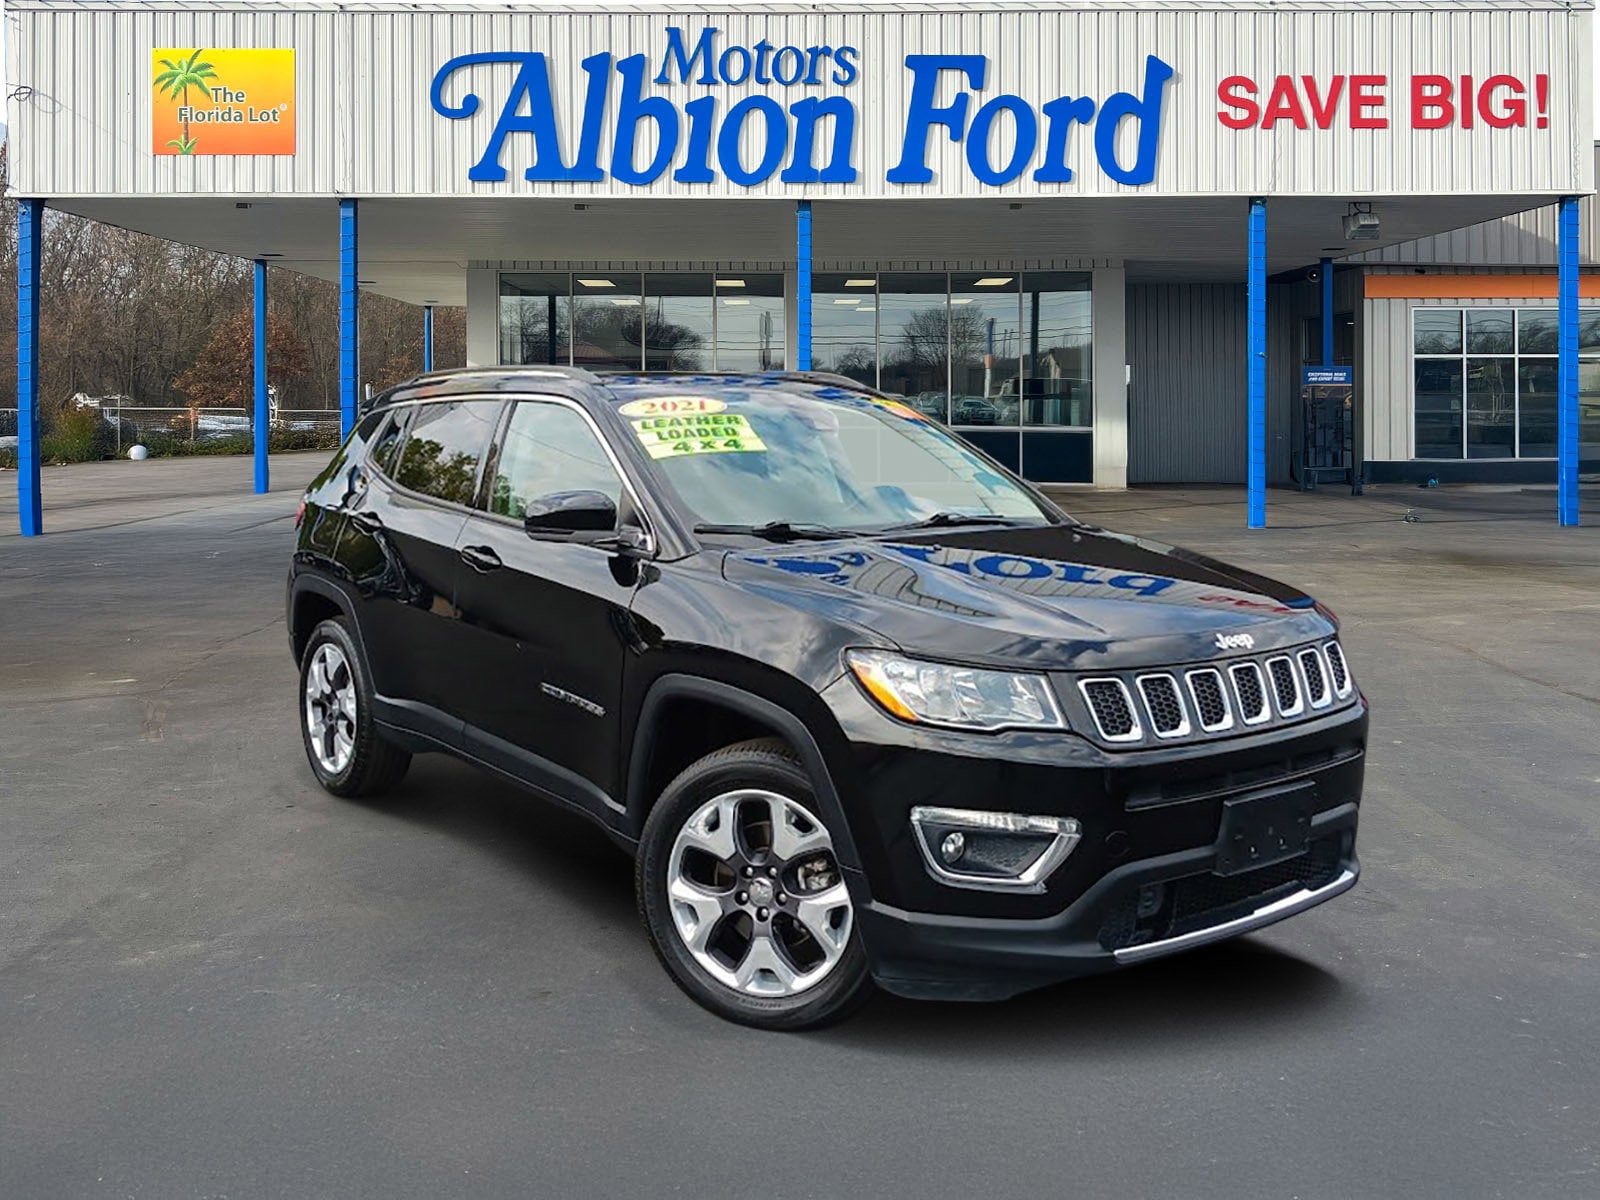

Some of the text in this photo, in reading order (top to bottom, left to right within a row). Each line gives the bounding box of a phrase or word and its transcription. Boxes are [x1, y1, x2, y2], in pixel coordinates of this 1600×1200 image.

[654, 27, 857, 86] Motors
[211, 87, 246, 103] The
[1218, 74, 1548, 129] SAVE BIG!
[178, 107, 279, 122] Florida Lot
[430, 52, 1174, 186] Albion Ford
[641, 400, 706, 413] 2021
[641, 415, 740, 430] LEATHER
[656, 427, 738, 441] LOADED
[1214, 633, 1255, 649] Jeep
